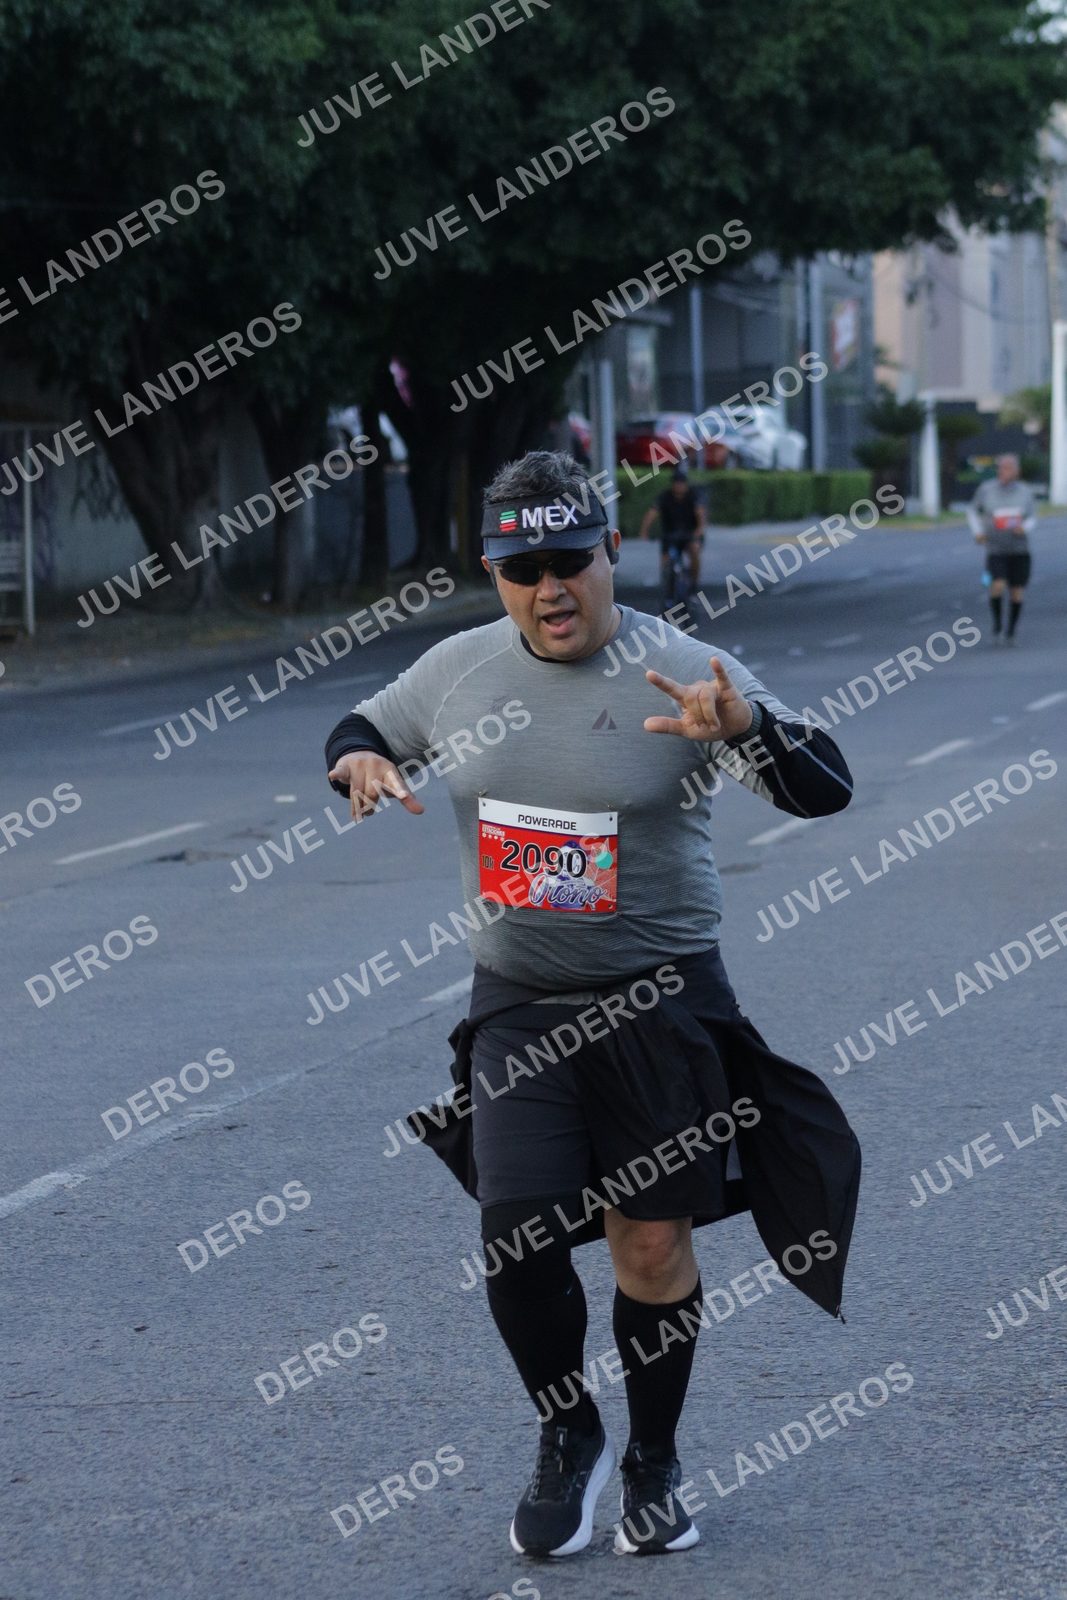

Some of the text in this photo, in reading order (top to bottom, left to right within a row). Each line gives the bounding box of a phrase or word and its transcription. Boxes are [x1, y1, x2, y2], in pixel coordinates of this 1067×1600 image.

[521, 504, 579, 529] MEX
[518, 814, 577, 831] POWERADE
[500, 839, 588, 878] 2090
